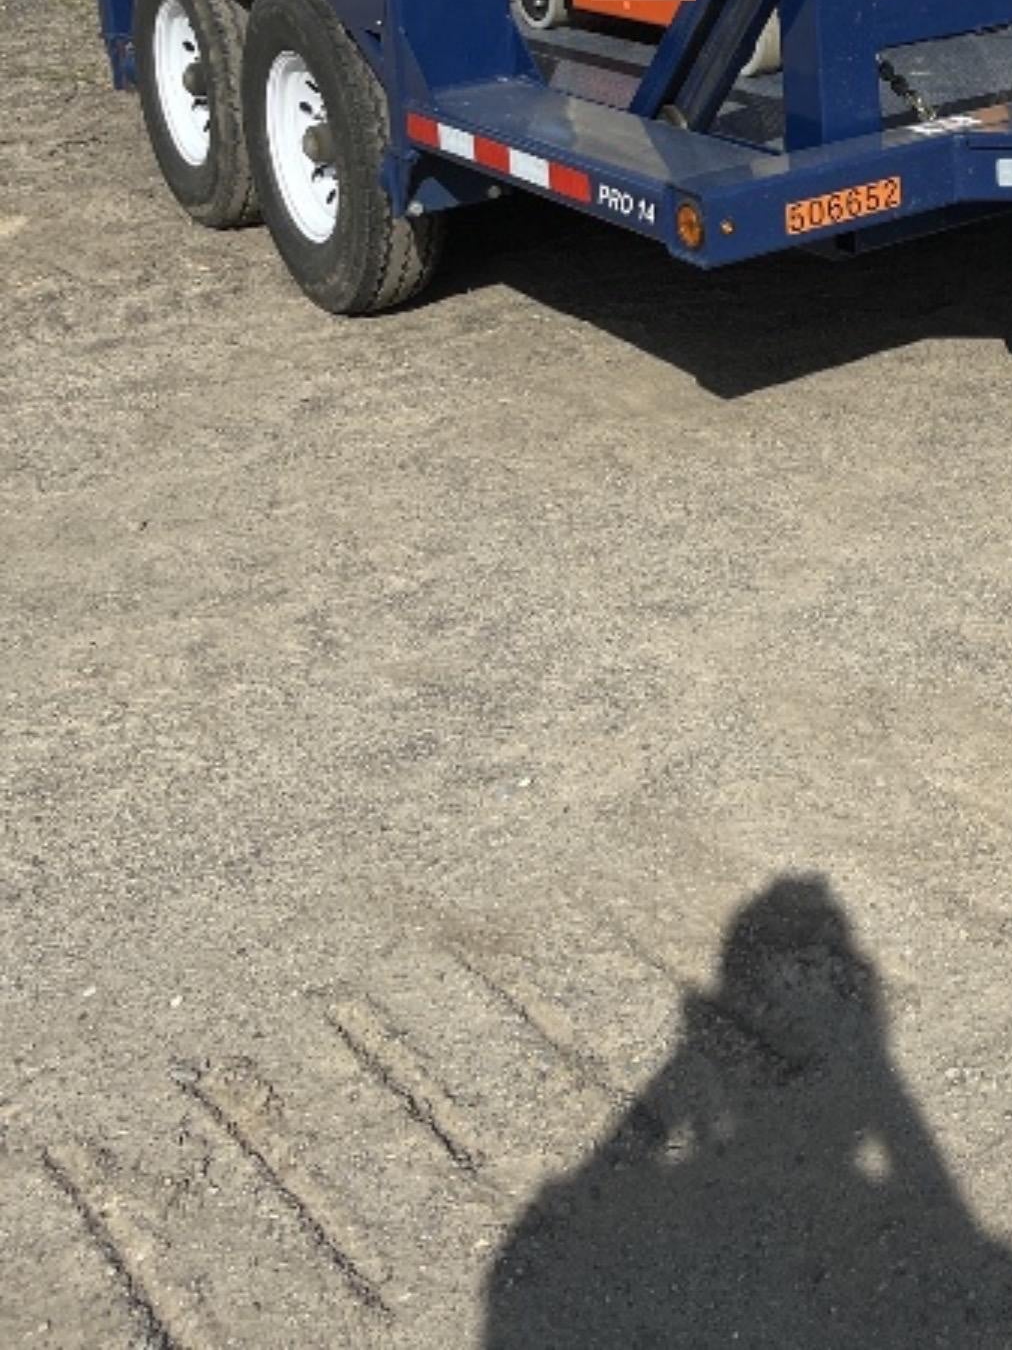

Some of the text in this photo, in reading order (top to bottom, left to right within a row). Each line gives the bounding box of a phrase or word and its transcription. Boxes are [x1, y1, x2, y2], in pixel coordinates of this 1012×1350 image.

[599, 184, 656, 226] PRO 14
[789, 179, 899, 233] 506652
